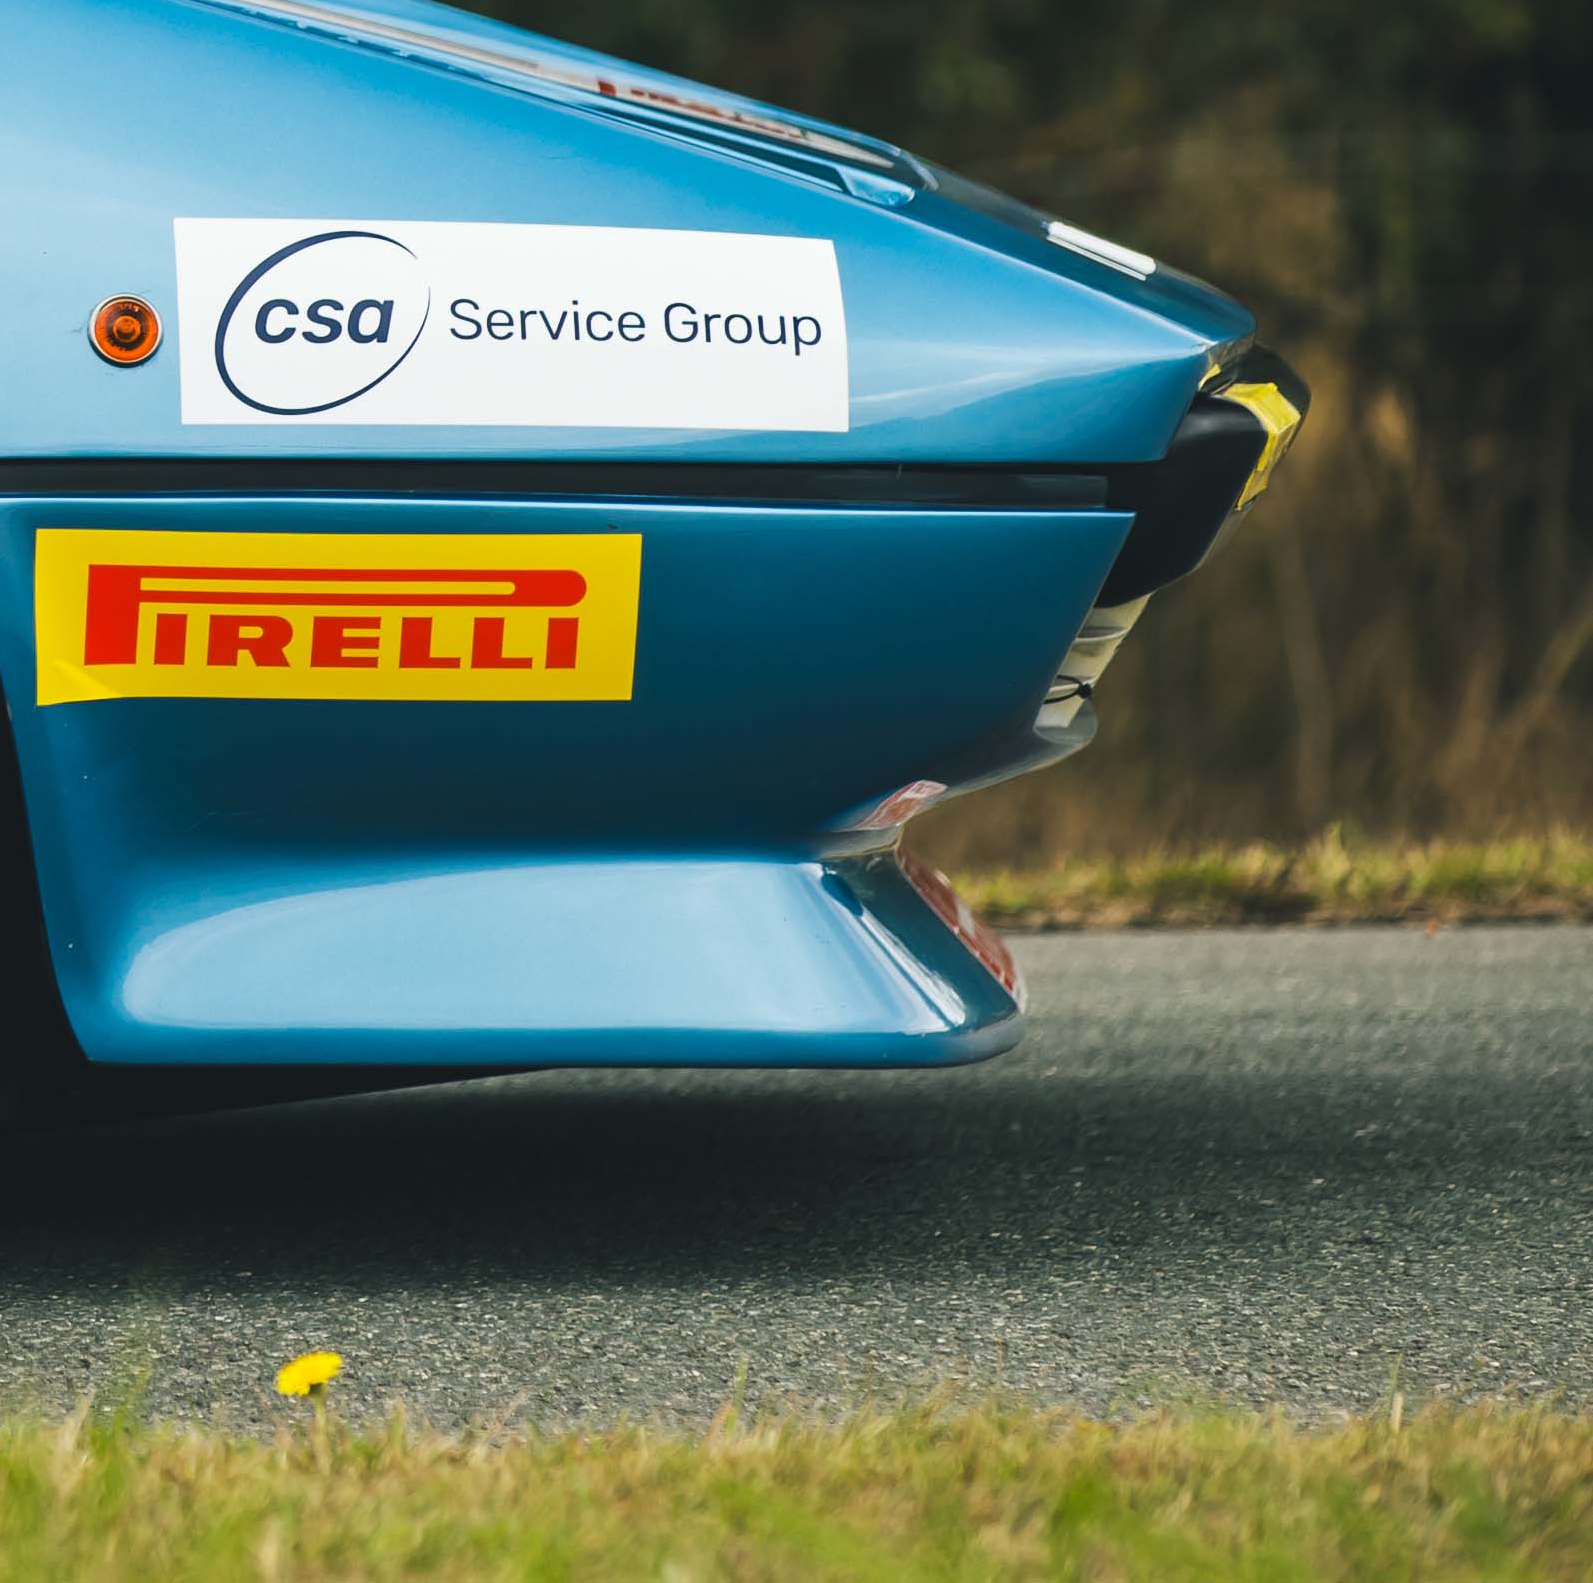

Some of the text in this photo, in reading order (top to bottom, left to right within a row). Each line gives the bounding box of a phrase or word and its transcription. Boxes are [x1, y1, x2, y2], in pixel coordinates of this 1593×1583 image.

[255, 297, 823, 356] csa Service Group
[84, 564, 588, 670] PIRELLI
